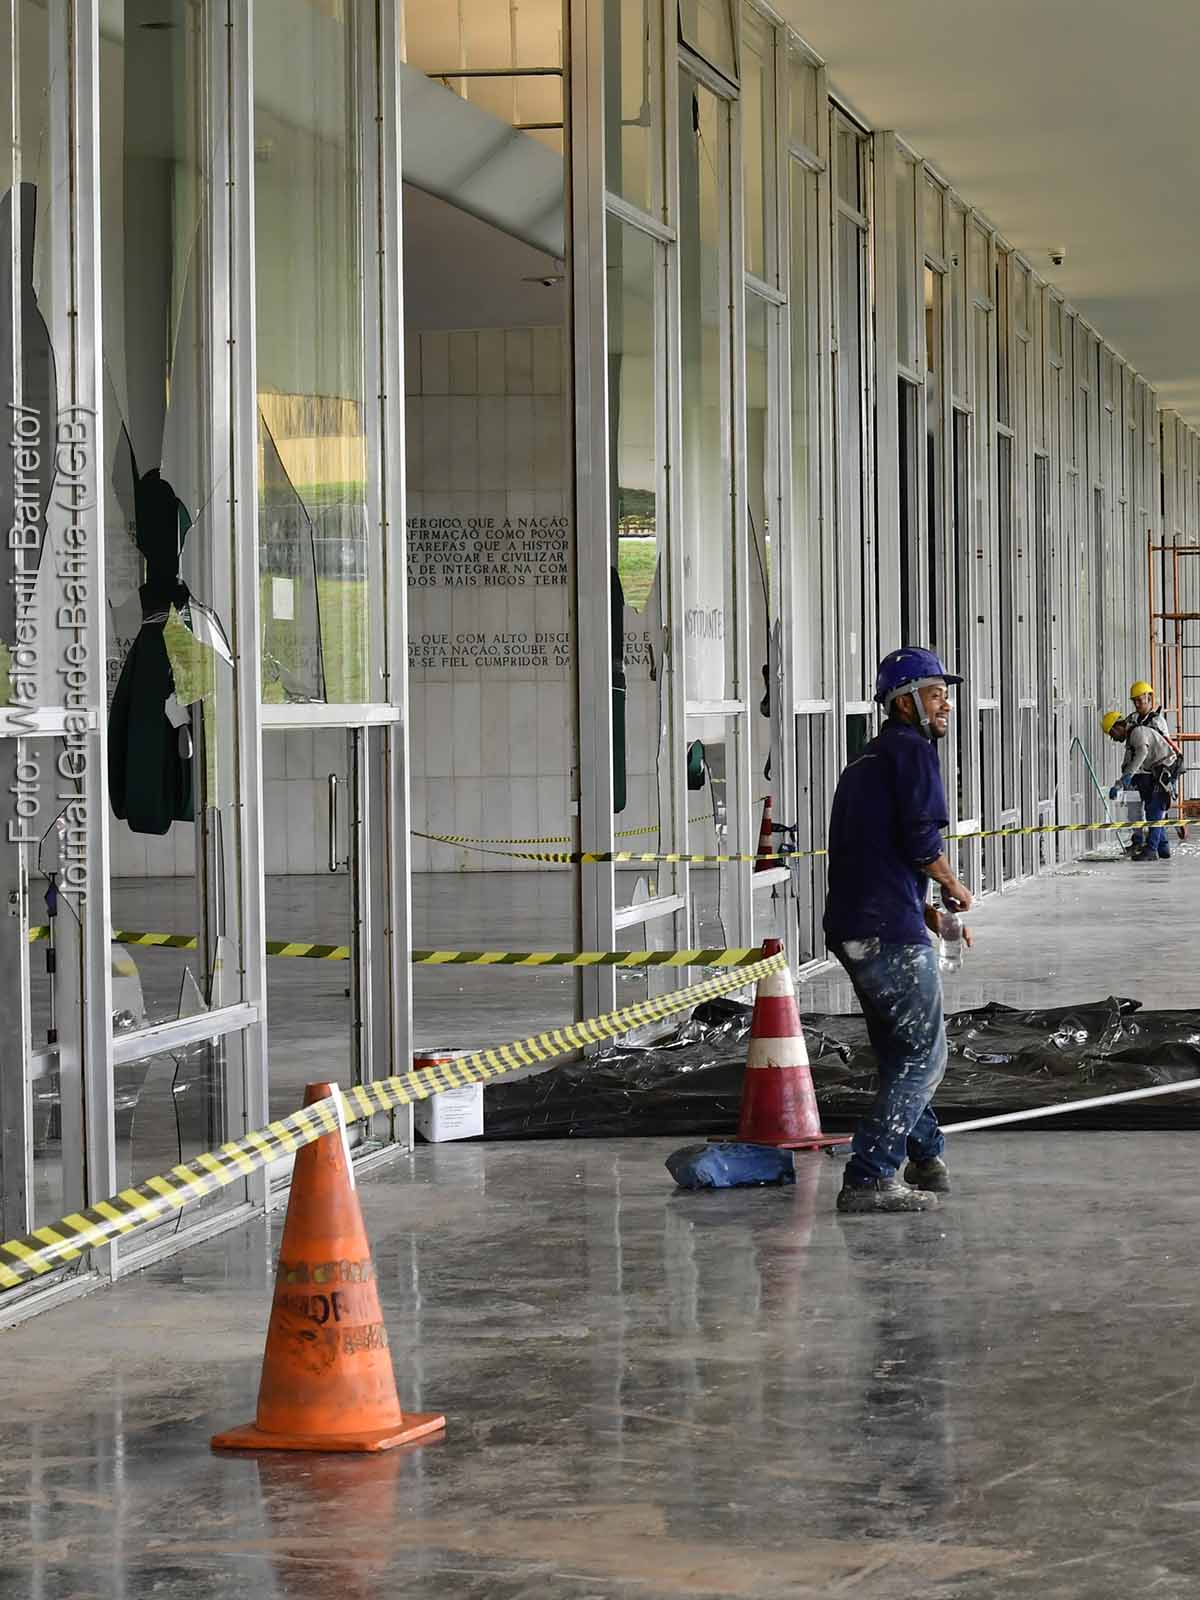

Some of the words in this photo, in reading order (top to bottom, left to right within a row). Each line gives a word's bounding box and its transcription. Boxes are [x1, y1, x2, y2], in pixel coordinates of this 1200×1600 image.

[467, 518, 495, 530] QUE
[502, 518, 513, 528] A
[518, 515, 569, 529] NAÇÃO
[407, 530, 480, 542] FIRMAÇÃO
[485, 529, 526, 540] COMO
[531, 529, 566, 540] POVO
[408, 541, 466, 552] TAREFAS
[474, 541, 500, 552] QUE
[508, 541, 517, 551] A
[425, 553, 480, 564] POVOAR
[487, 553, 495, 563] E
[501, 552, 564, 563] CIVILIZAR
[419, 564, 439, 575] DE
[513, 564, 532, 574] NA
[538, 564, 568, 574] COM
[408, 575, 437, 586] DOS
[445, 575, 477, 586] MAIS
[484, 575, 526, 586] RICOS
[534, 576, 568, 586] TERR
[456, 633, 486, 644] COM
[492, 633, 528, 644] ALTO
[408, 646, 447, 657] DESTA
[503, 645, 546, 655] SOUBE
[442, 657, 469, 668] FIEL
[475, 656, 549, 667] CUMPRIDOR
